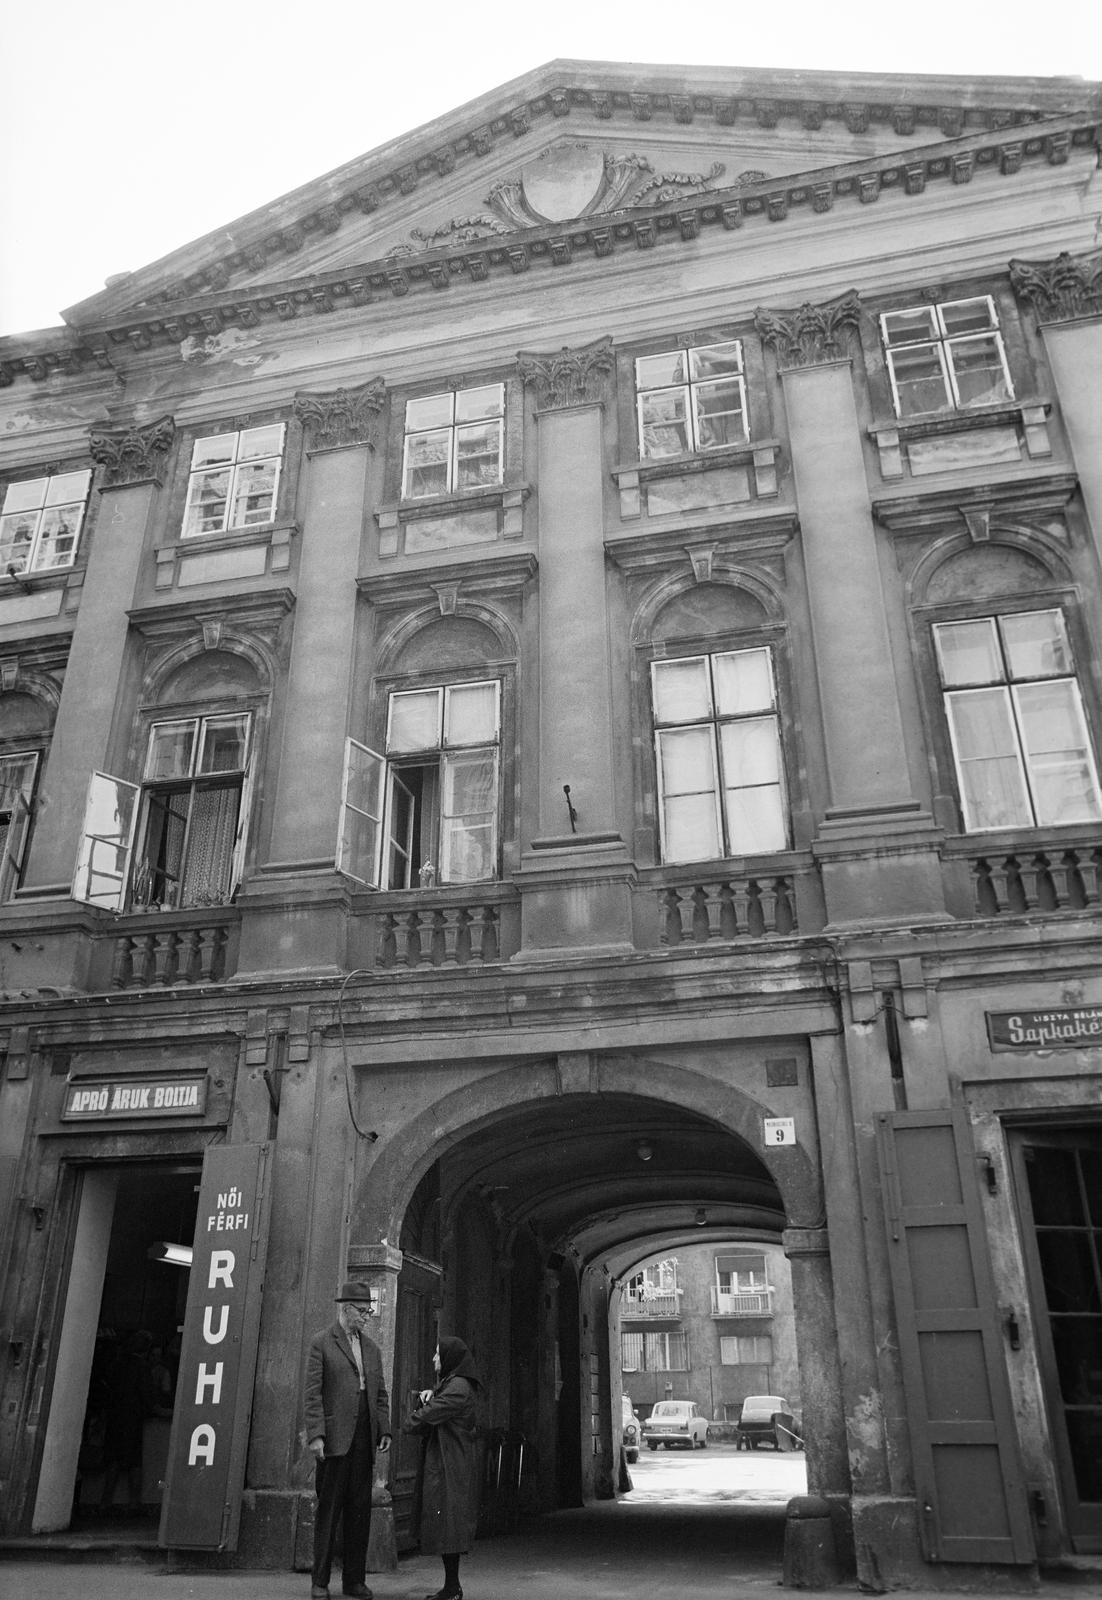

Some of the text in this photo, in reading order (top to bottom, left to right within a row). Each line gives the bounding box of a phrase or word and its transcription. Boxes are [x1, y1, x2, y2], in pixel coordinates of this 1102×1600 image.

[1008, 1016, 1102, 1046] Sapkaké
[111, 1087, 151, 1110] ÁRUK
[154, 1085, 198, 1108] BOLTJA
[776, 1129, 785, 1142] 9
[217, 1186, 242, 1209] NŐI
[207, 1211, 248, 1232] FÉRFI
[188, 1249, 236, 1466] RUHA
